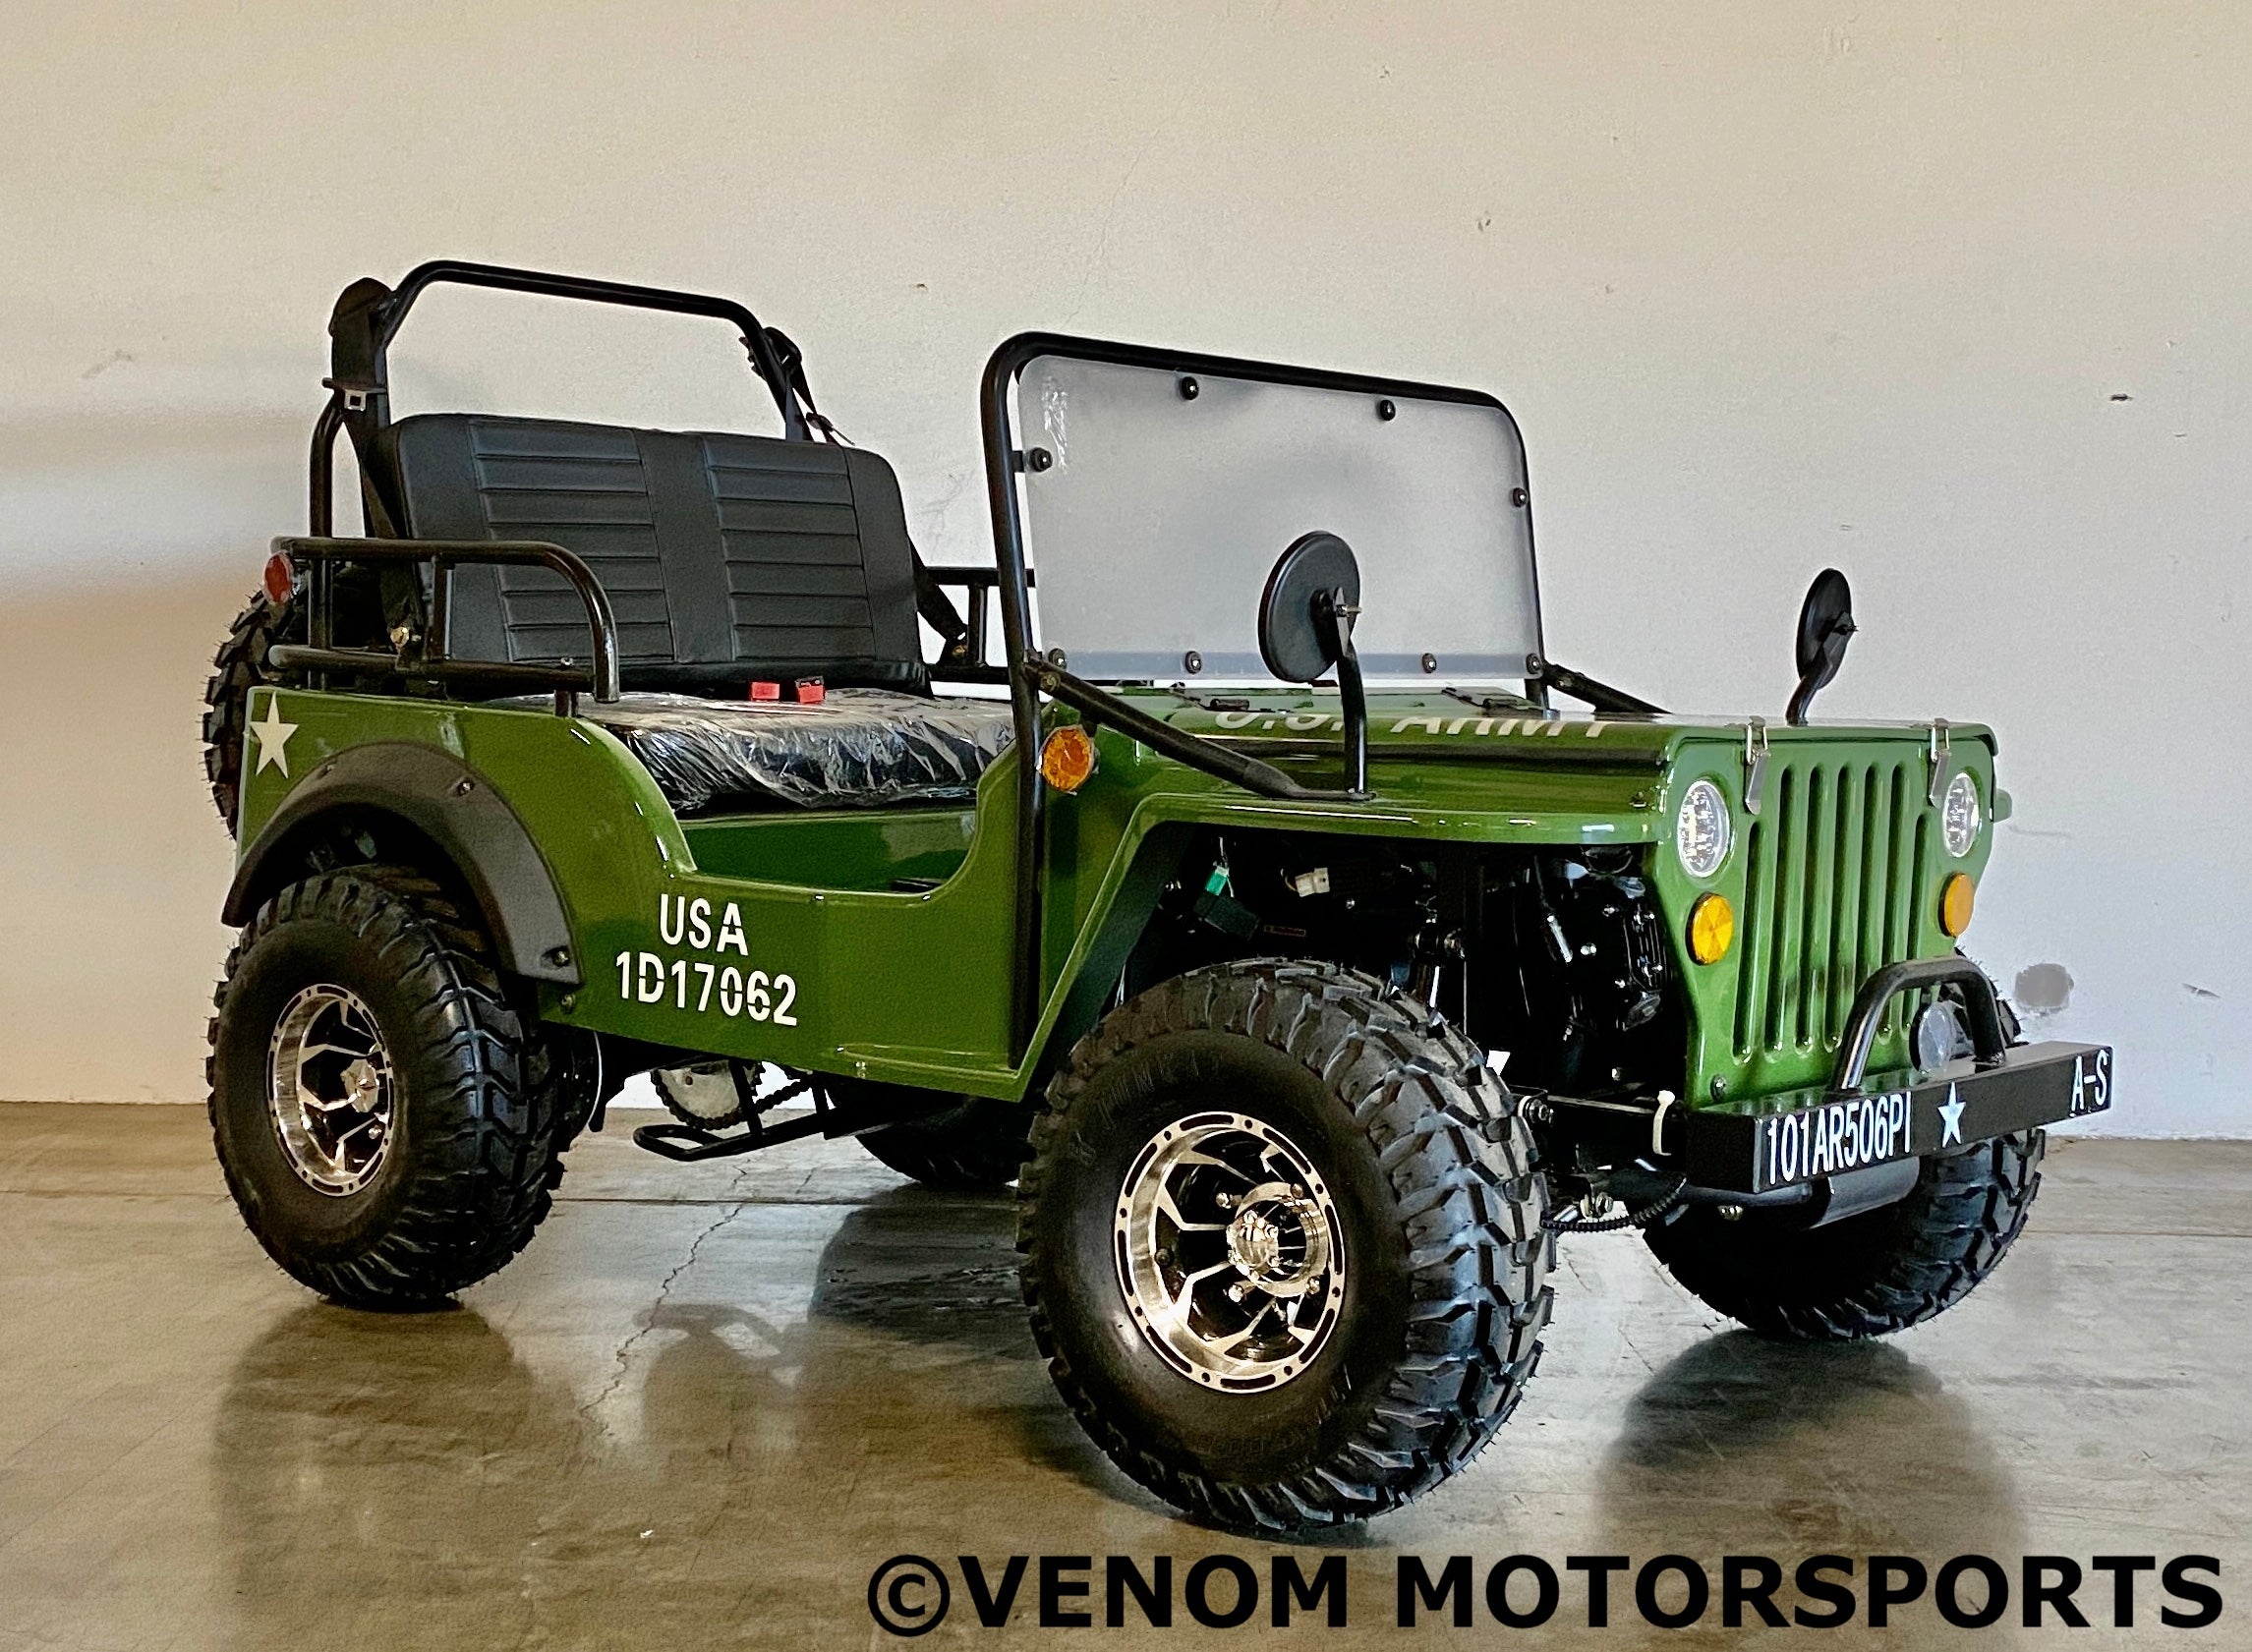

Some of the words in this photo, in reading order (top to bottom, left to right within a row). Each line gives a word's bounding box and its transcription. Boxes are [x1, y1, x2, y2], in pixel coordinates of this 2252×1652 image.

[660, 893, 749, 956] USA
[615, 950, 798, 1026] 1D17062
[2070, 1049, 2109, 1111] A-S
